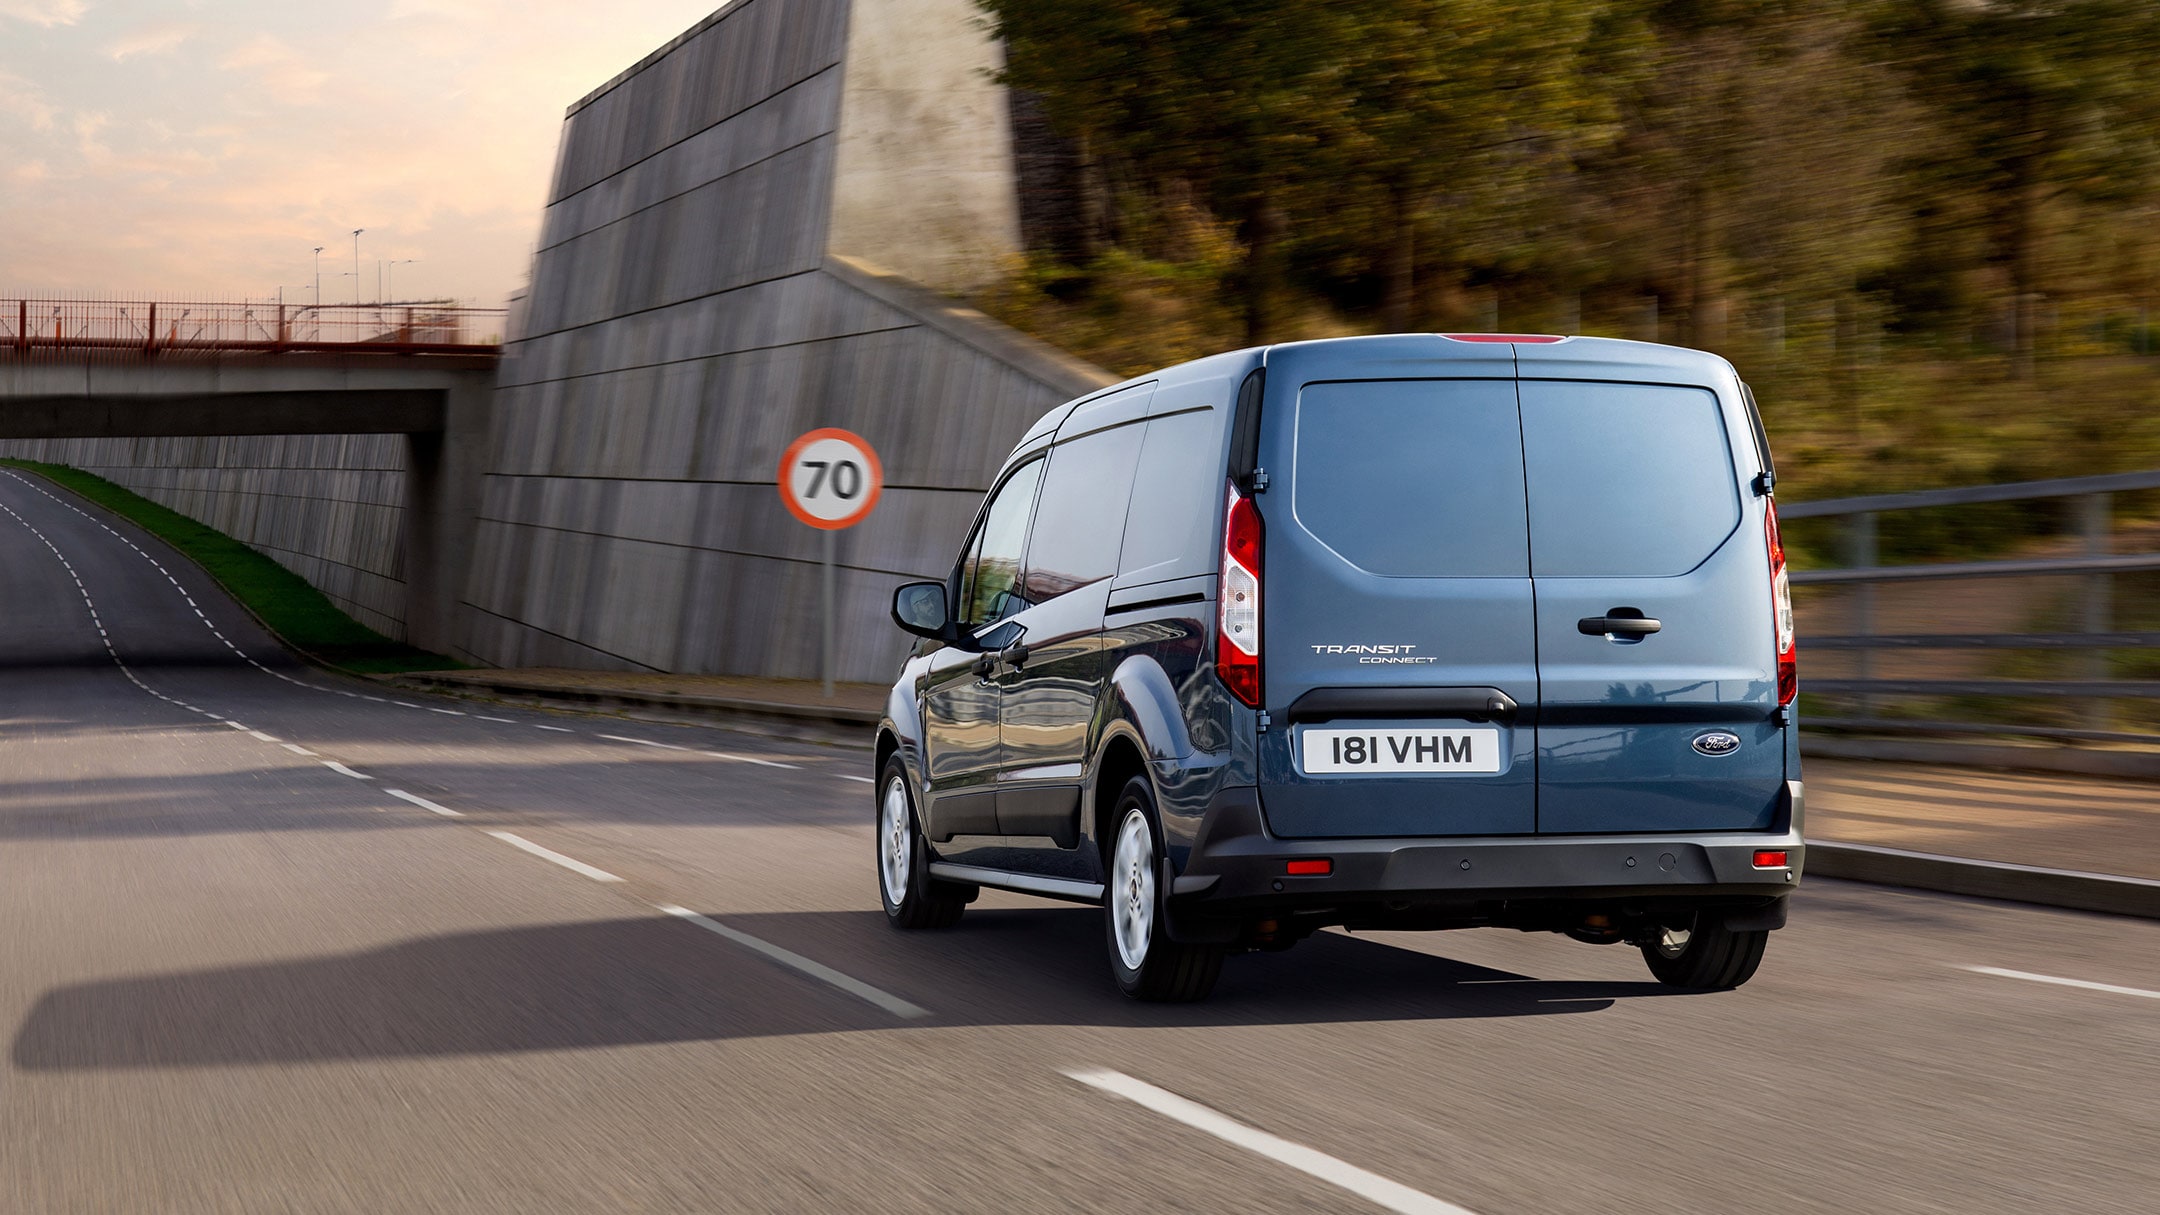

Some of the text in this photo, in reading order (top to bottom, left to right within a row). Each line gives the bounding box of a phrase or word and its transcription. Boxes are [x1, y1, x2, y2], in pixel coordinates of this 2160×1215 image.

[801, 460, 862, 499] 70
[1311, 645, 1416, 654] TRANSIT
[1332, 735, 1473, 765] 181 VHM
[1705, 736, 1731, 749] Ford
